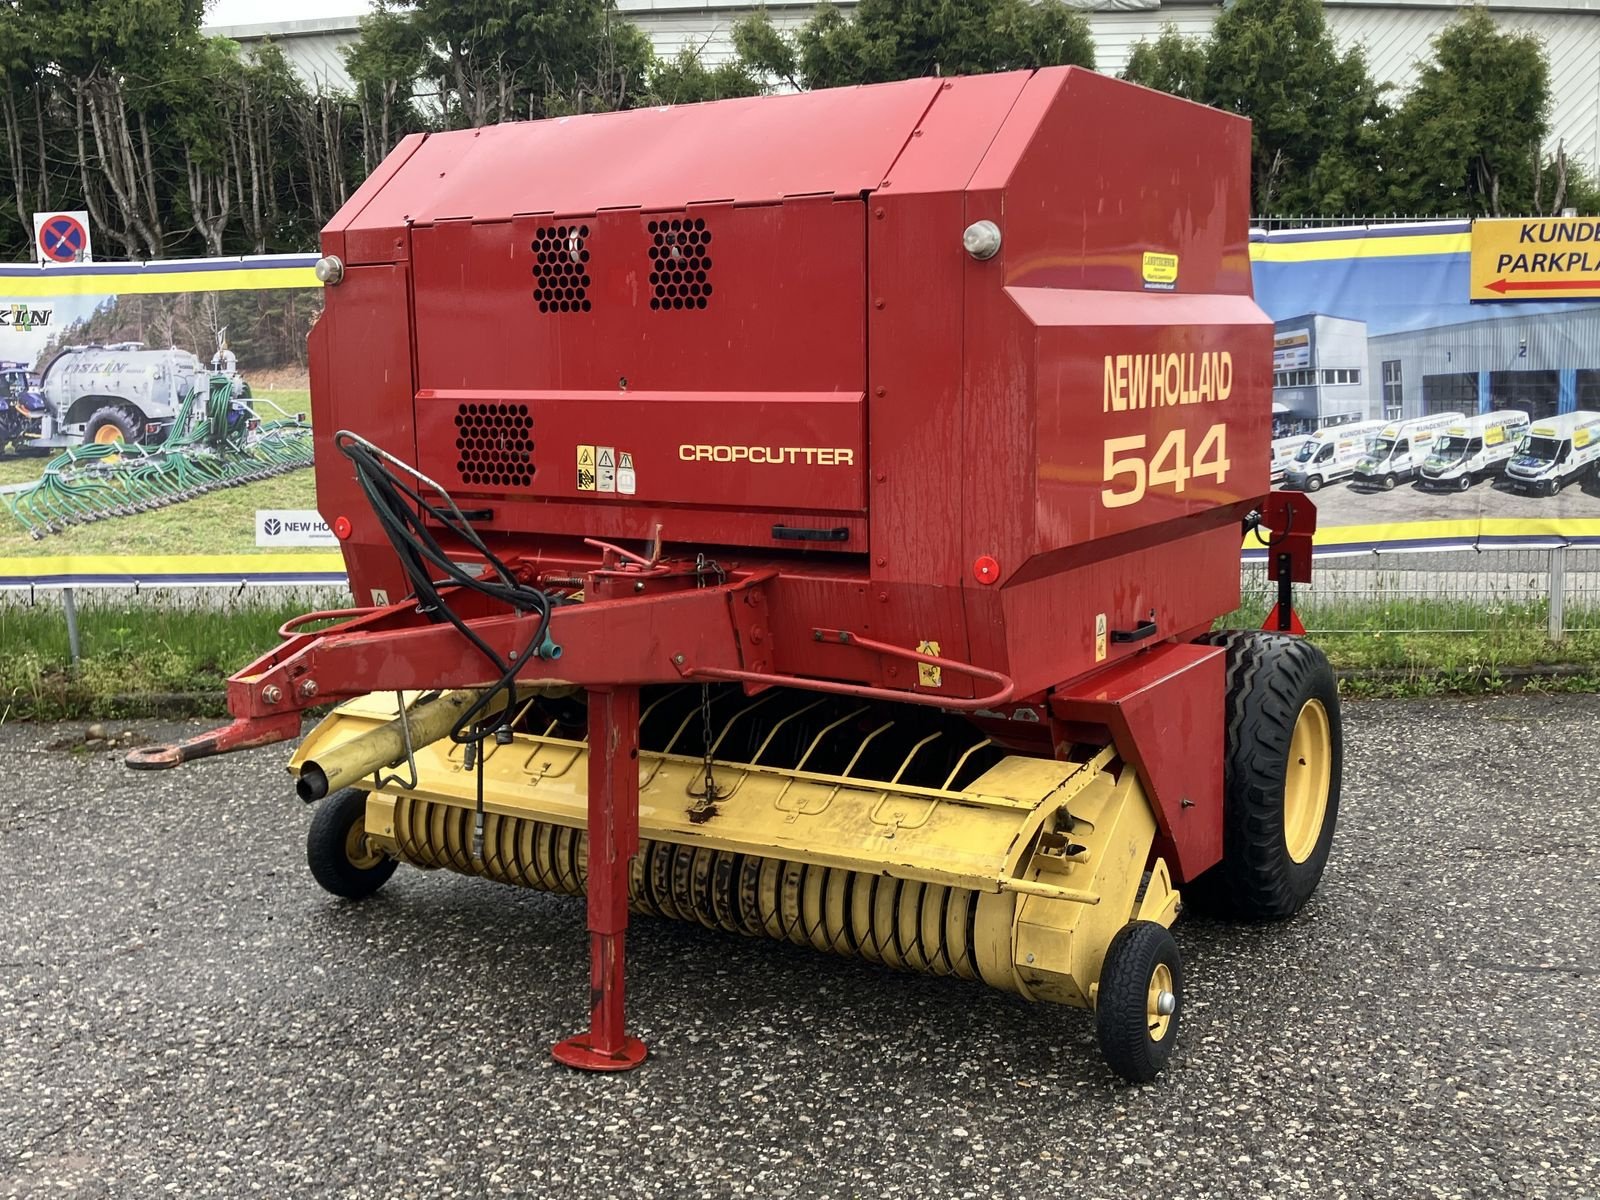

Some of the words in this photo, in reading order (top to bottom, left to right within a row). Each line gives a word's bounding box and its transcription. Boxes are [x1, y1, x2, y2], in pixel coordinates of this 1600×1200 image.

[1518, 346, 1527, 358] 2
[1103, 354, 1150, 412] NEW
[1151, 351, 1233, 408] HOLLAND
[678, 444, 854, 466] CROPCUTTER
[1101, 423, 1231, 509] 544
[284, 522, 311, 532] NEW
